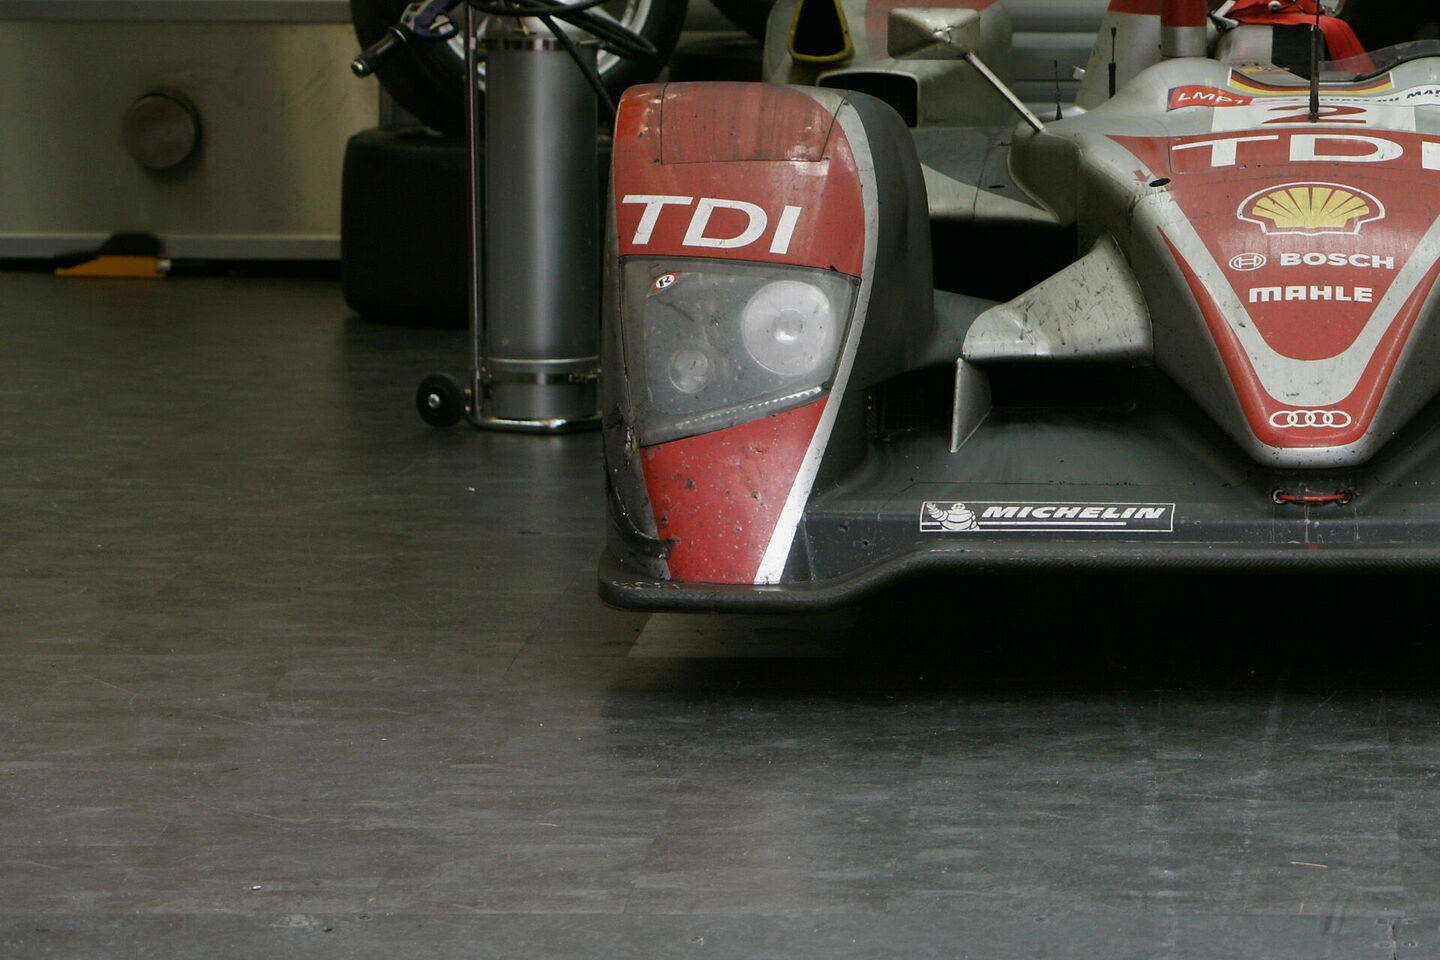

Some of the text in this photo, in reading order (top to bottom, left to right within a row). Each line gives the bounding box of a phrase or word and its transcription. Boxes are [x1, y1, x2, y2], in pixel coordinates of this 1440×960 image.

[1262, 105, 1367, 124] 2
[622, 194, 802, 254] TDI
[1280, 252, 1394, 270] BOSCH
[1249, 285, 1373, 303] MAHLE
[981, 505, 1166, 520] MICHELIN
